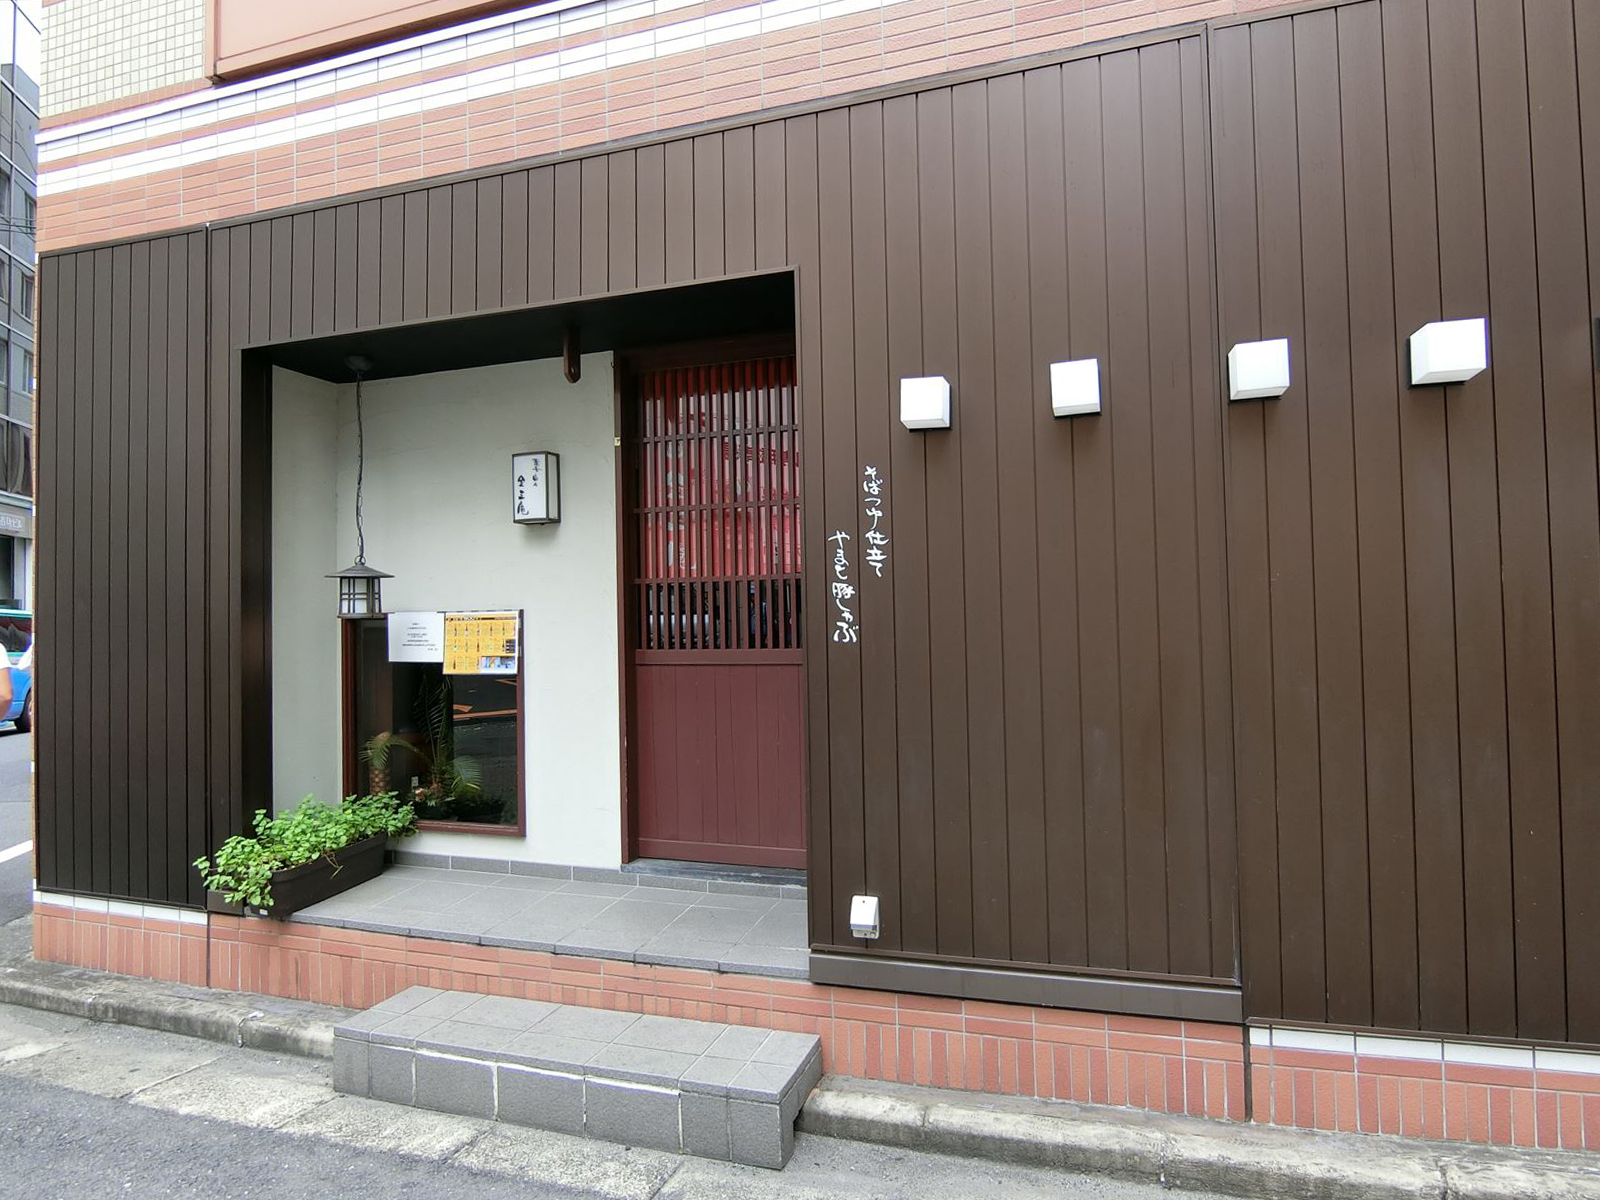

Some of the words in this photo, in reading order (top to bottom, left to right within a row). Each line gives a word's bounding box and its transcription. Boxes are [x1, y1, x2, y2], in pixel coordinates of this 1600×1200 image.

[862, 465, 890, 578] そばつゆ仕立て
[827, 530, 860, 643] やまと豚しゃぶ
